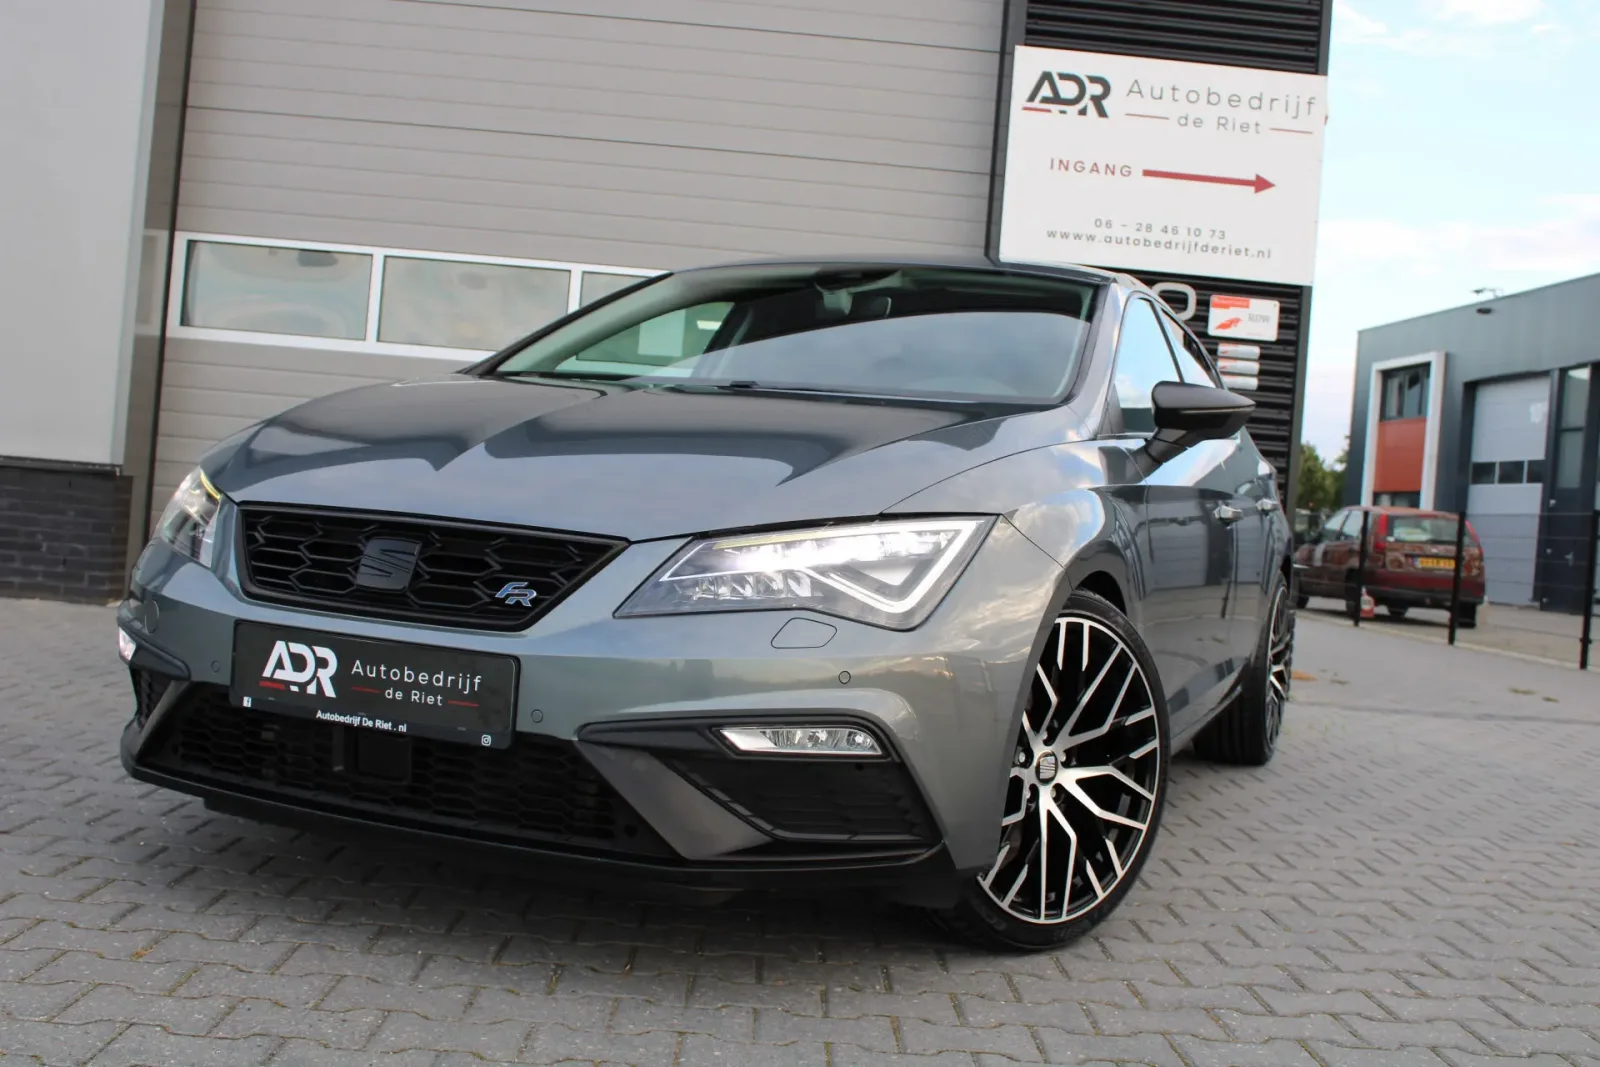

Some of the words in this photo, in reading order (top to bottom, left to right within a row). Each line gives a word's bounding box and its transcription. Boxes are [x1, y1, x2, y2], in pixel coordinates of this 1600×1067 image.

[1022, 70, 1112, 118] ADR
[1126, 79, 1317, 119] Autobedrijf
[1177, 113, 1204, 128] de
[1216, 116, 1262, 134] Riet
[1050, 158, 1133, 177] INGANG
[1094, 218, 1113, 229] 06
[1135, 222, 1153, 233] 28
[1160, 225, 1179, 236] 46
[1187, 227, 1202, 238] 10
[1210, 229, 1226, 240] 73
[495, 581, 537, 607] FR
[259, 640, 338, 698] ADR
[351, 660, 482, 694] Autobedrijf
[385, 687, 403, 700] de
[411, 690, 443, 706] Riet
[316, 709, 361, 727] Autobedrijf
[362, 718, 374, 727] De
[375, 719, 392, 730] Riet
